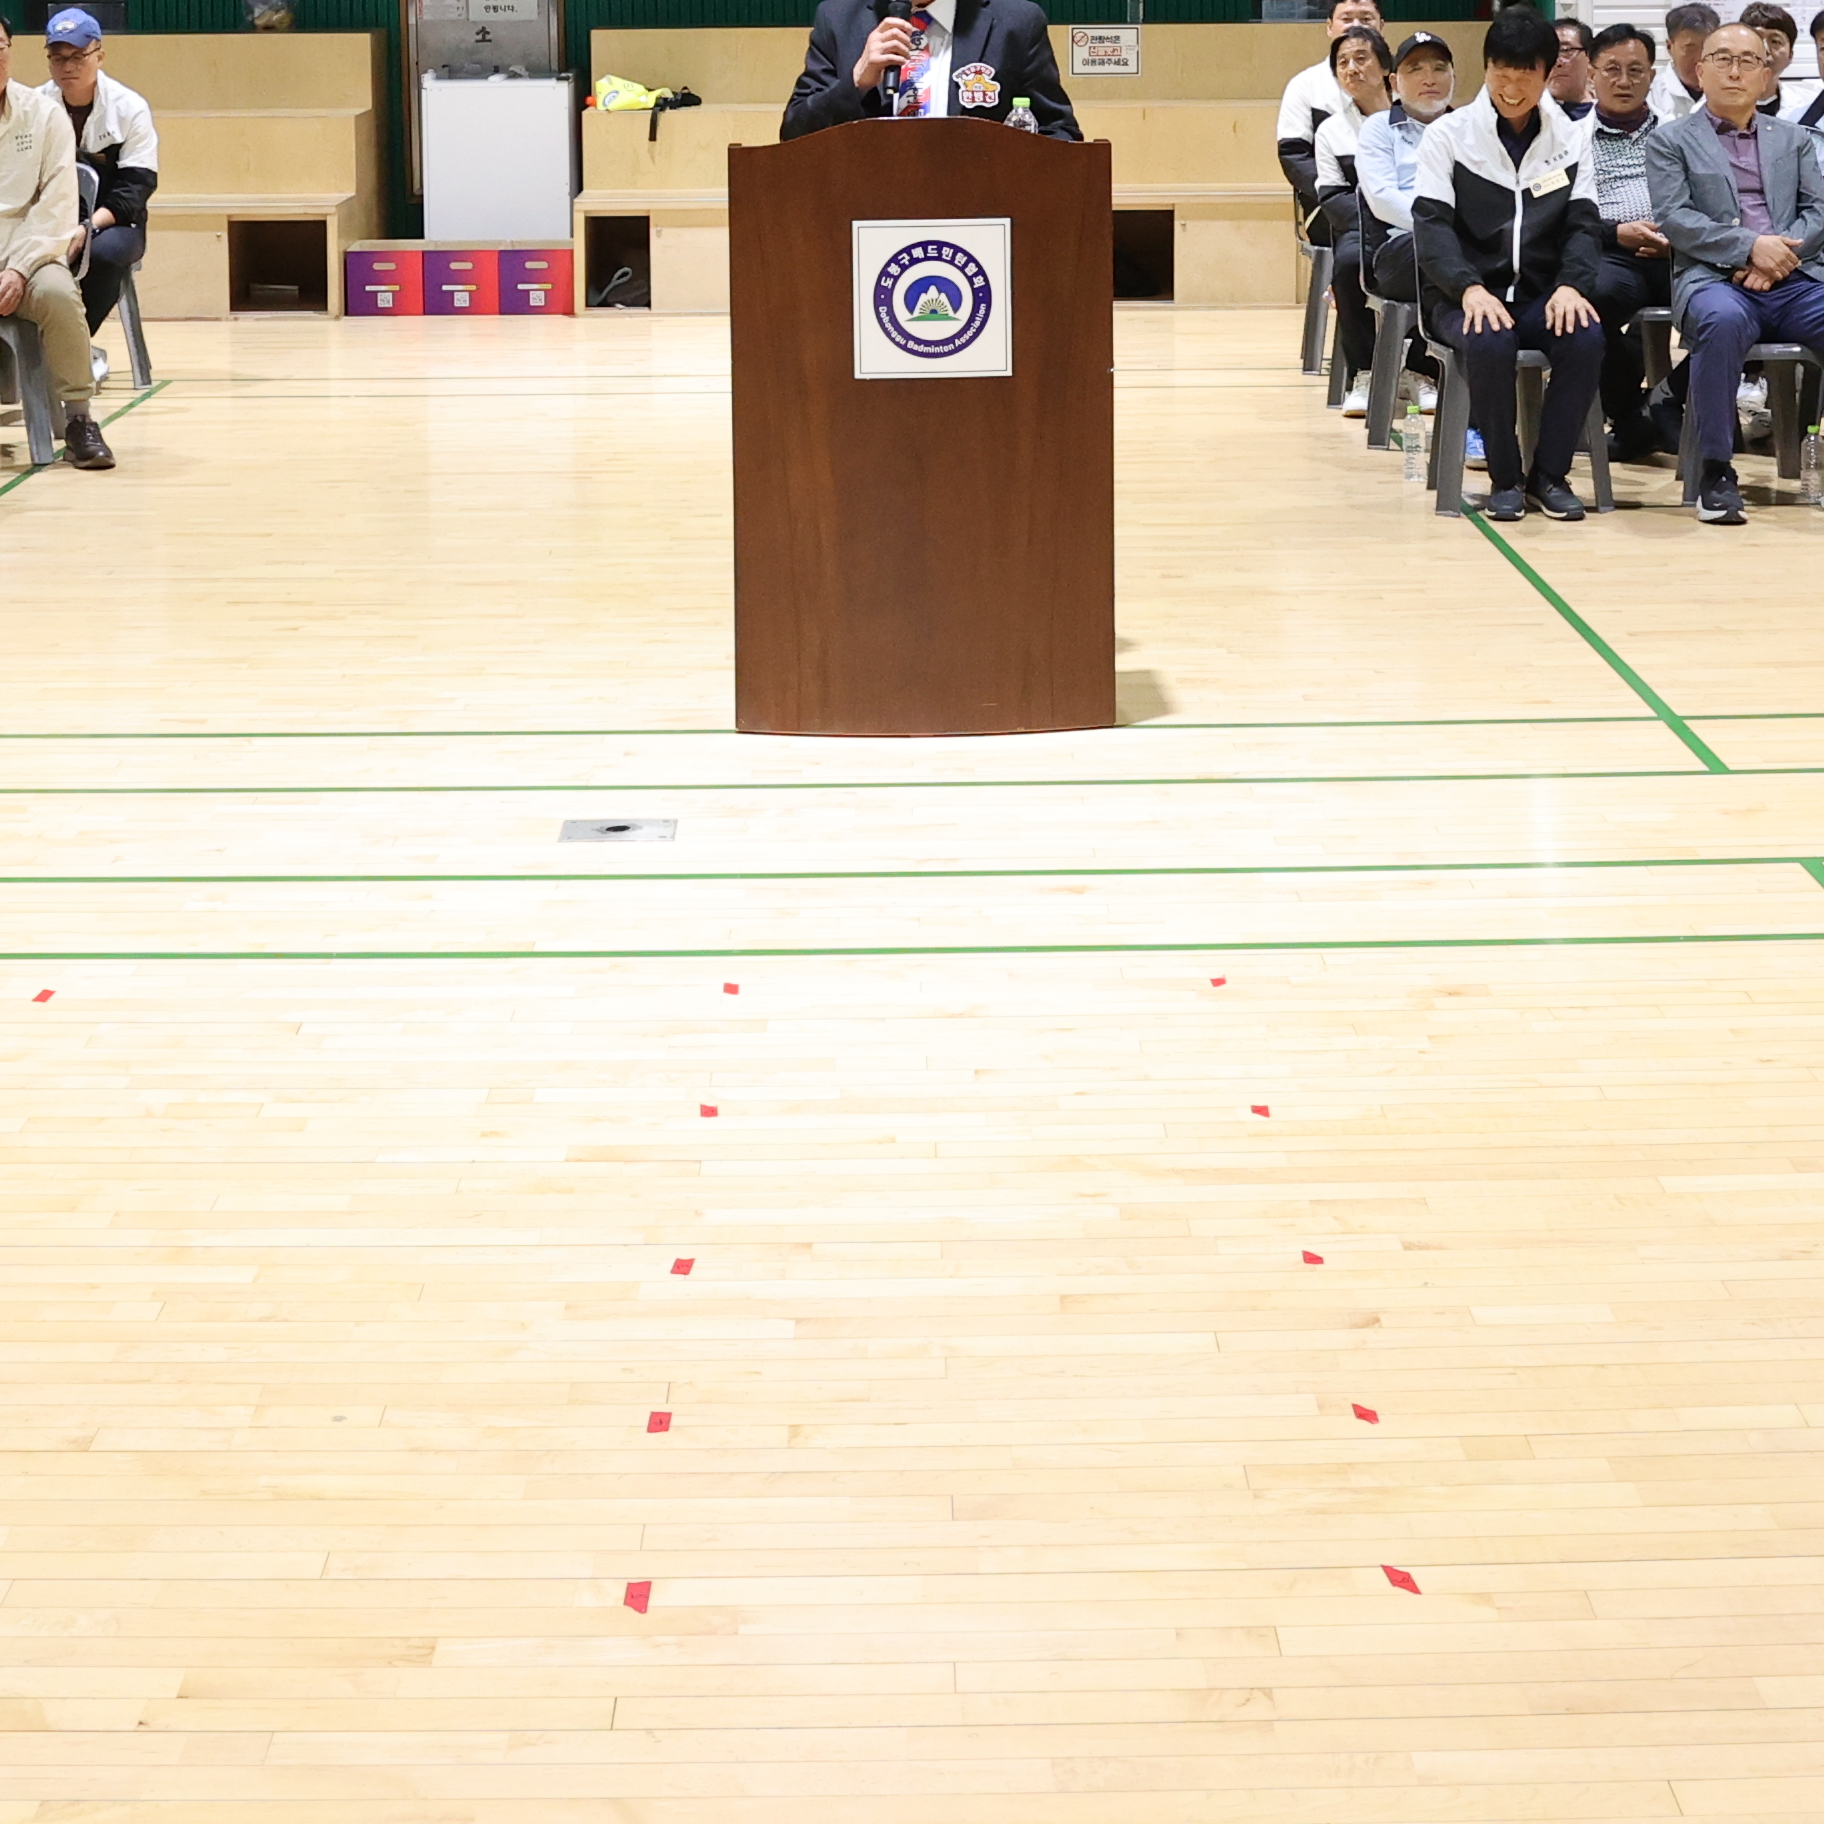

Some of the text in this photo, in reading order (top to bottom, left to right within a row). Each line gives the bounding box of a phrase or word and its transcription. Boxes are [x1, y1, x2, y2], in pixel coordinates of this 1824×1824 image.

[475, 26, 493, 43] 소
[880, 245, 986, 289] 도봉구배드민턴협회
[878, 303, 987, 354] Dobonggu Badminton Association
